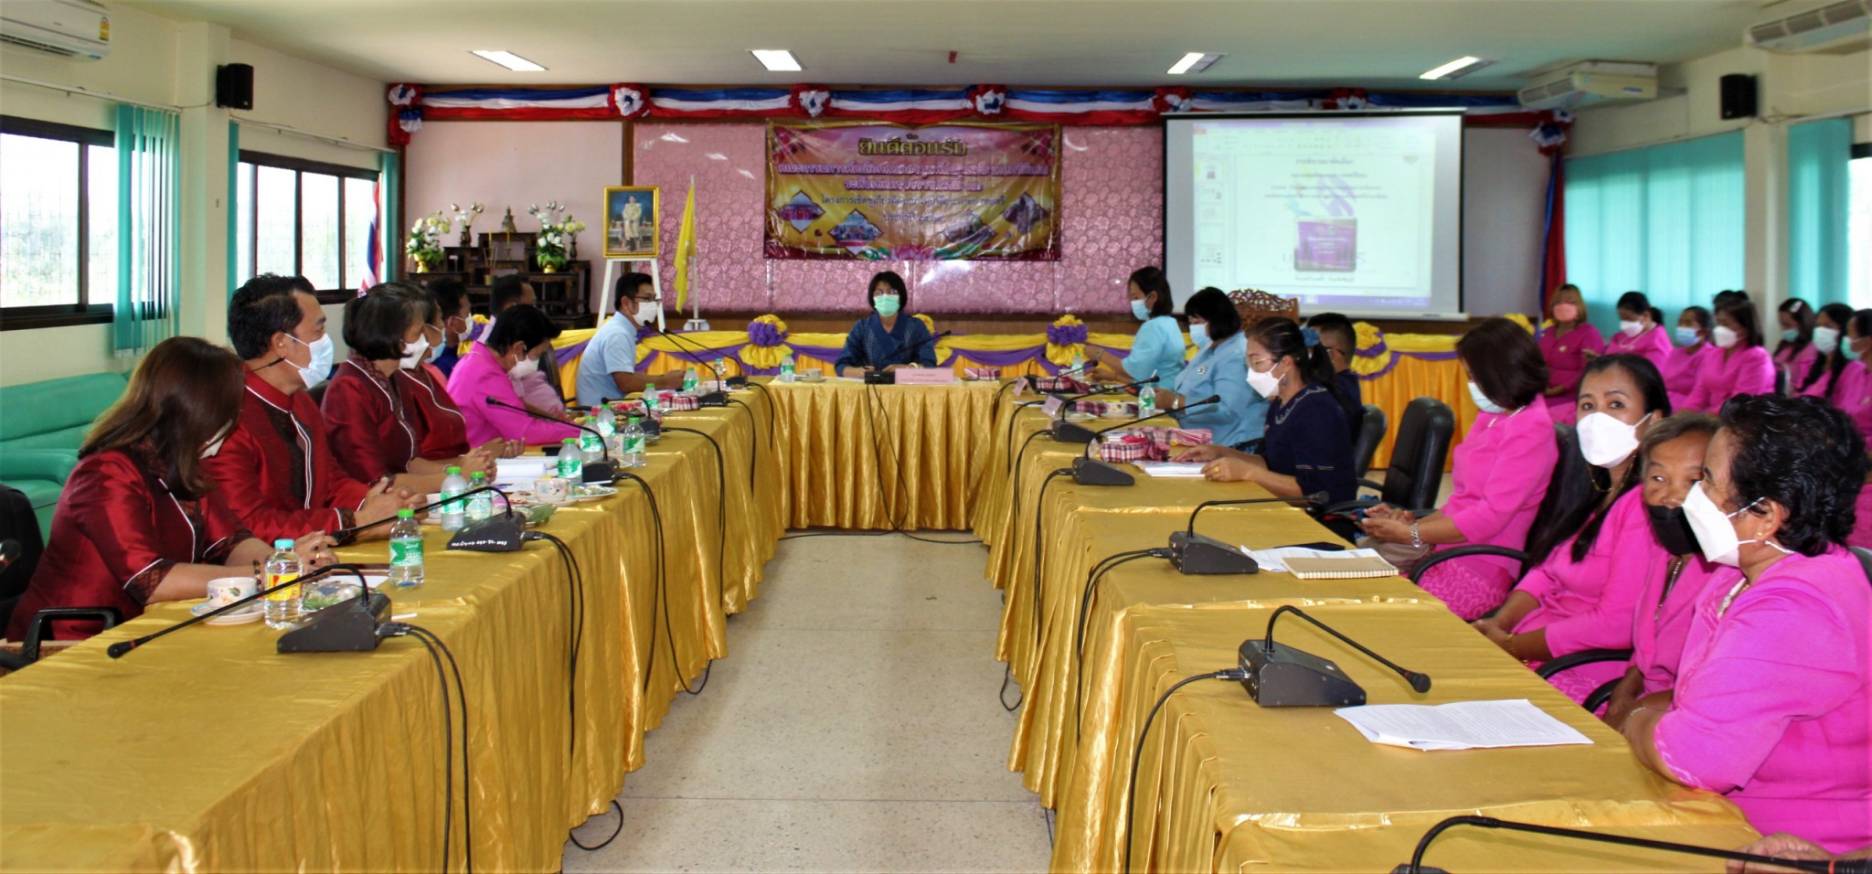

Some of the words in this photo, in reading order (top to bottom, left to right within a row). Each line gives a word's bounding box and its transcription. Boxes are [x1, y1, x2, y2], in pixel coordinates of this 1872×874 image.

[858, 133, 968, 156] ยินดีต้อนรับ
